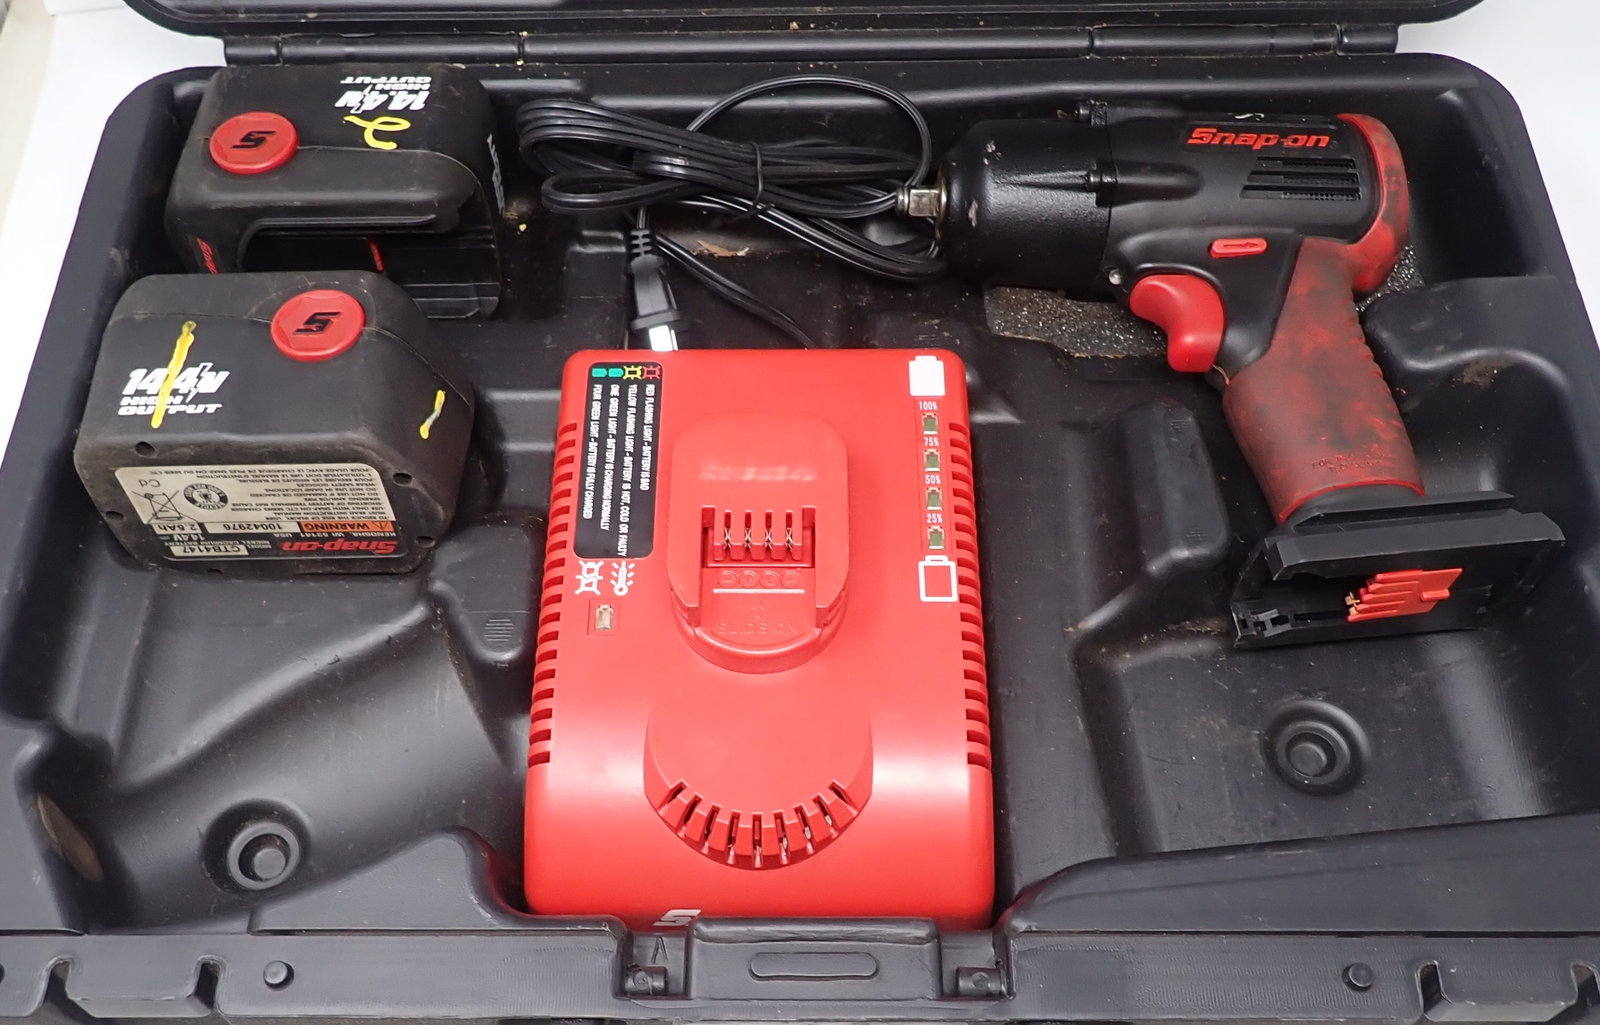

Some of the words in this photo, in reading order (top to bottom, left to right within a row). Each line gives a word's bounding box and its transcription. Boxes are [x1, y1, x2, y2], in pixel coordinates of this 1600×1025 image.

[341, 76, 432, 85] OUTPUT
[374, 83, 430, 91] HIGH
[335, 88, 430, 113] 14.4V
[343, 115, 412, 150] 2
[1187, 127, 1330, 150] Snap-on
[593, 385, 602, 399] FOUR
[610, 385, 619, 396] ONE
[628, 385, 637, 406] YELLOW
[646, 384, 655, 396] RED
[591, 401, 601, 420] GREEN
[609, 398, 619, 417] GREEN
[644, 397, 654, 424] FLASHING
[919, 401, 938, 410] 100%
[608, 418, 617, 434] LIGHT
[626, 408, 636, 434] FLASHING
[590, 421, 599, 438] LIGHT
[643, 425, 652, 442] LIGHT
[625, 436, 634, 452] LIGHT
[924, 437, 939, 446] 75%
[139, 478, 161, 489] Cd
[586, 473, 595, 491] FULLY
[603, 470, 613, 499] CHARGING
[640, 478, 649, 491] BAD
[925, 475, 941, 484] 50%
[583, 491, 594, 519] CHARGED
[620, 491, 630, 505] HOT,
[601, 500, 611, 530] NORMALLY
[620, 506, 629, 522] COLD
[927, 514, 943, 523] 25%
[619, 524, 628, 533] OR
[281, 538, 398, 555] Snap-on
[617, 535, 627, 556] FAULTY
